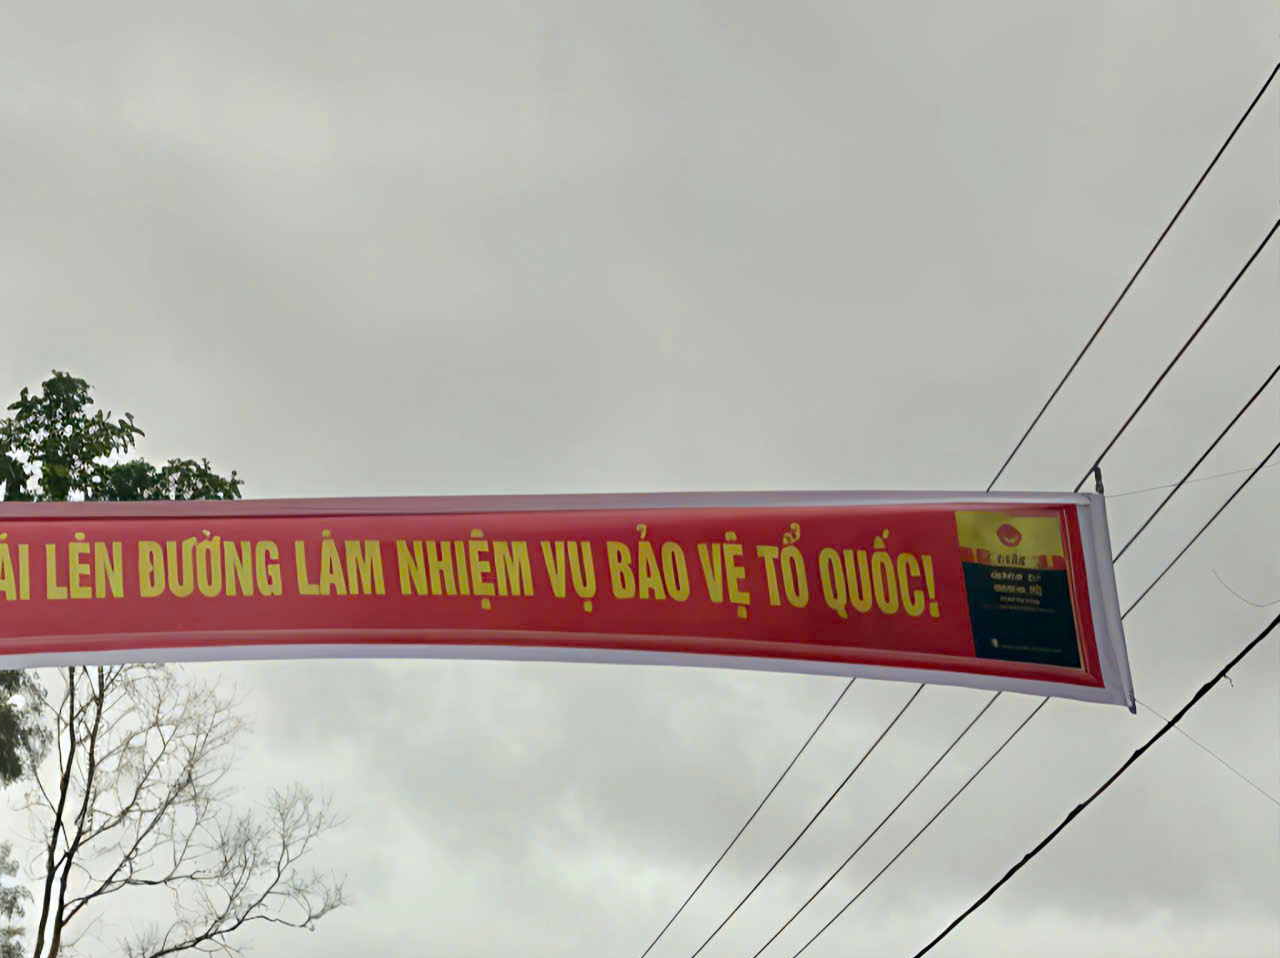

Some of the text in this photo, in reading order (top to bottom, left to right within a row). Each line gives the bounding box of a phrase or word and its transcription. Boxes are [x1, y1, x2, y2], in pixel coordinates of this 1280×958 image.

[138, 530, 283, 598] ĐƯỜNG
[396, 529, 534, 610] NHIỆM
[541, 540, 596, 613] VỤ
[607, 524, 690, 601] BẢO
[697, 532, 751, 619] VỆ
[756, 523, 809, 608] TỔ
[818, 530, 939, 619] QUỐC!
